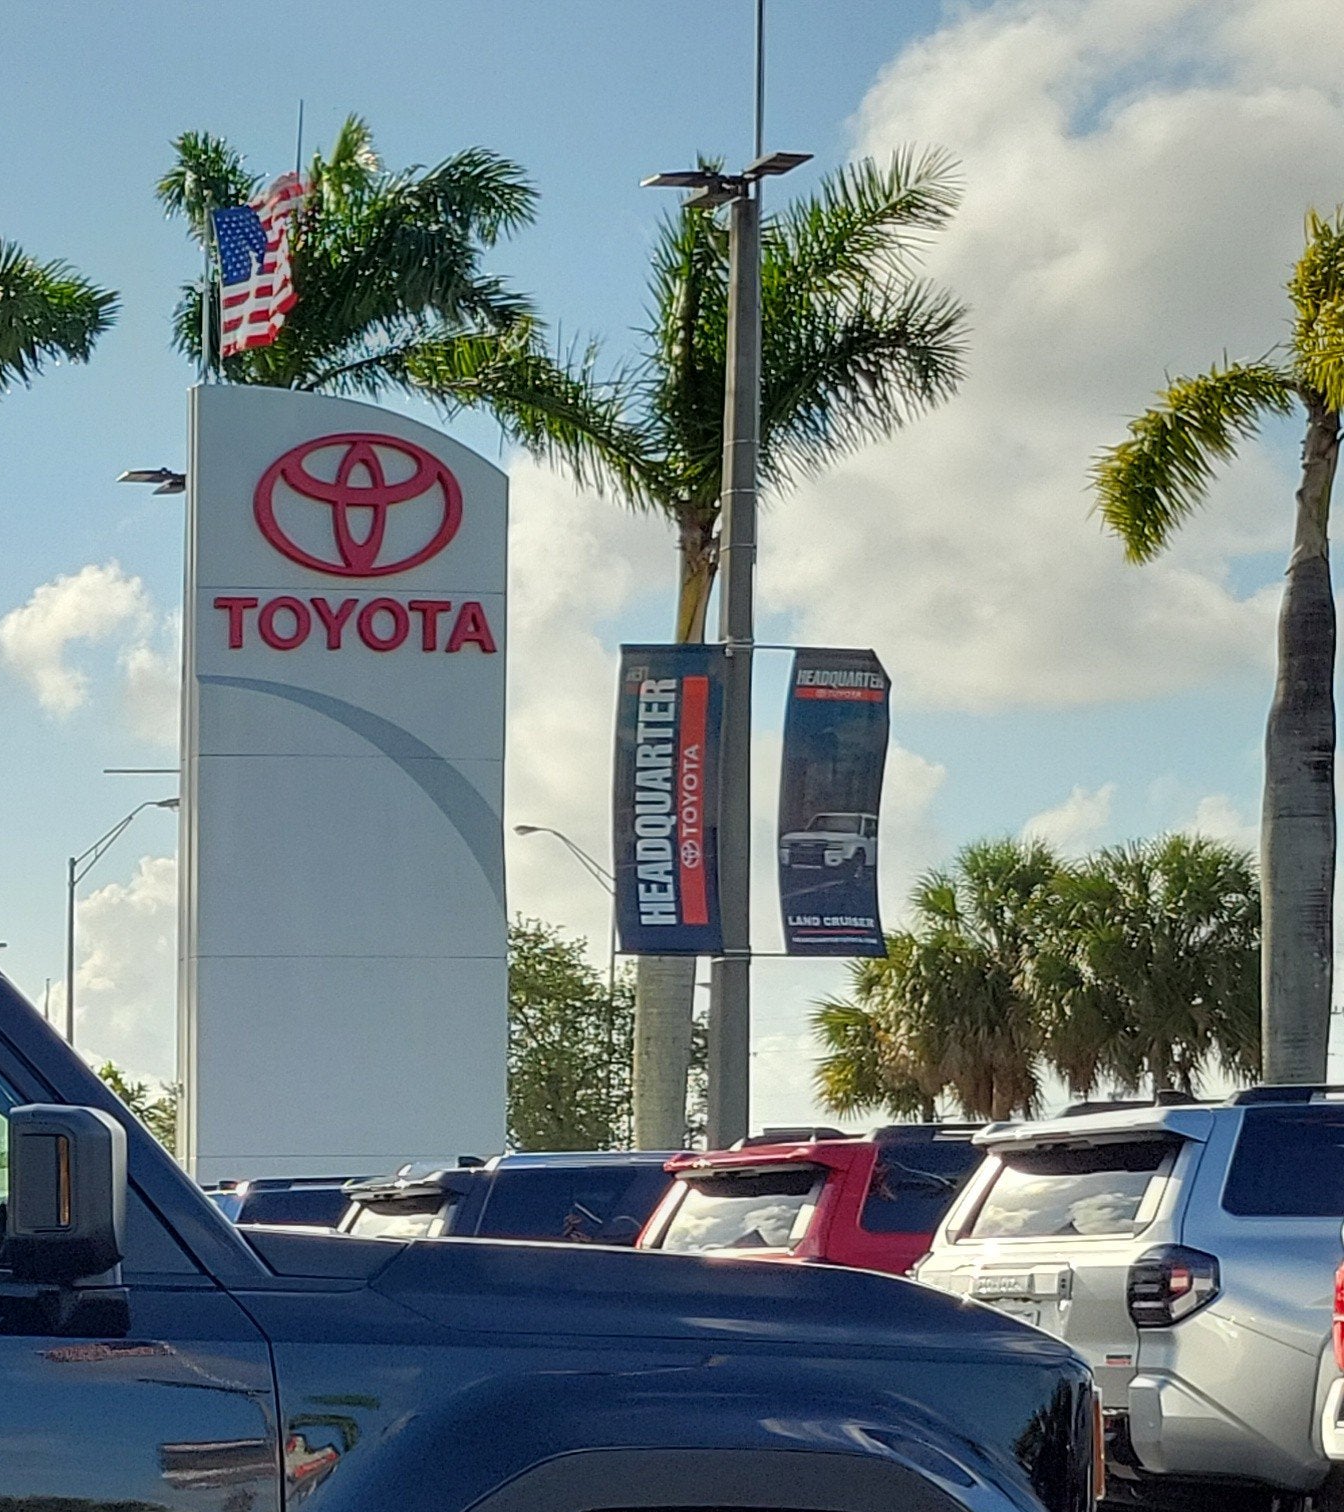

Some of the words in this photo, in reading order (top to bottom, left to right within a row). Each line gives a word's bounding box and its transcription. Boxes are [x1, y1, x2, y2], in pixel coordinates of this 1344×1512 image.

[213, 596, 497, 653] TOYOTA
[796, 669, 885, 689] HEADQUARTER
[634, 678, 678, 926] HEADQUARTER
[682, 744, 701, 836] TOYOTA
[788, 915, 820, 926] LAND
[823, 916, 875, 928] CRUISER
